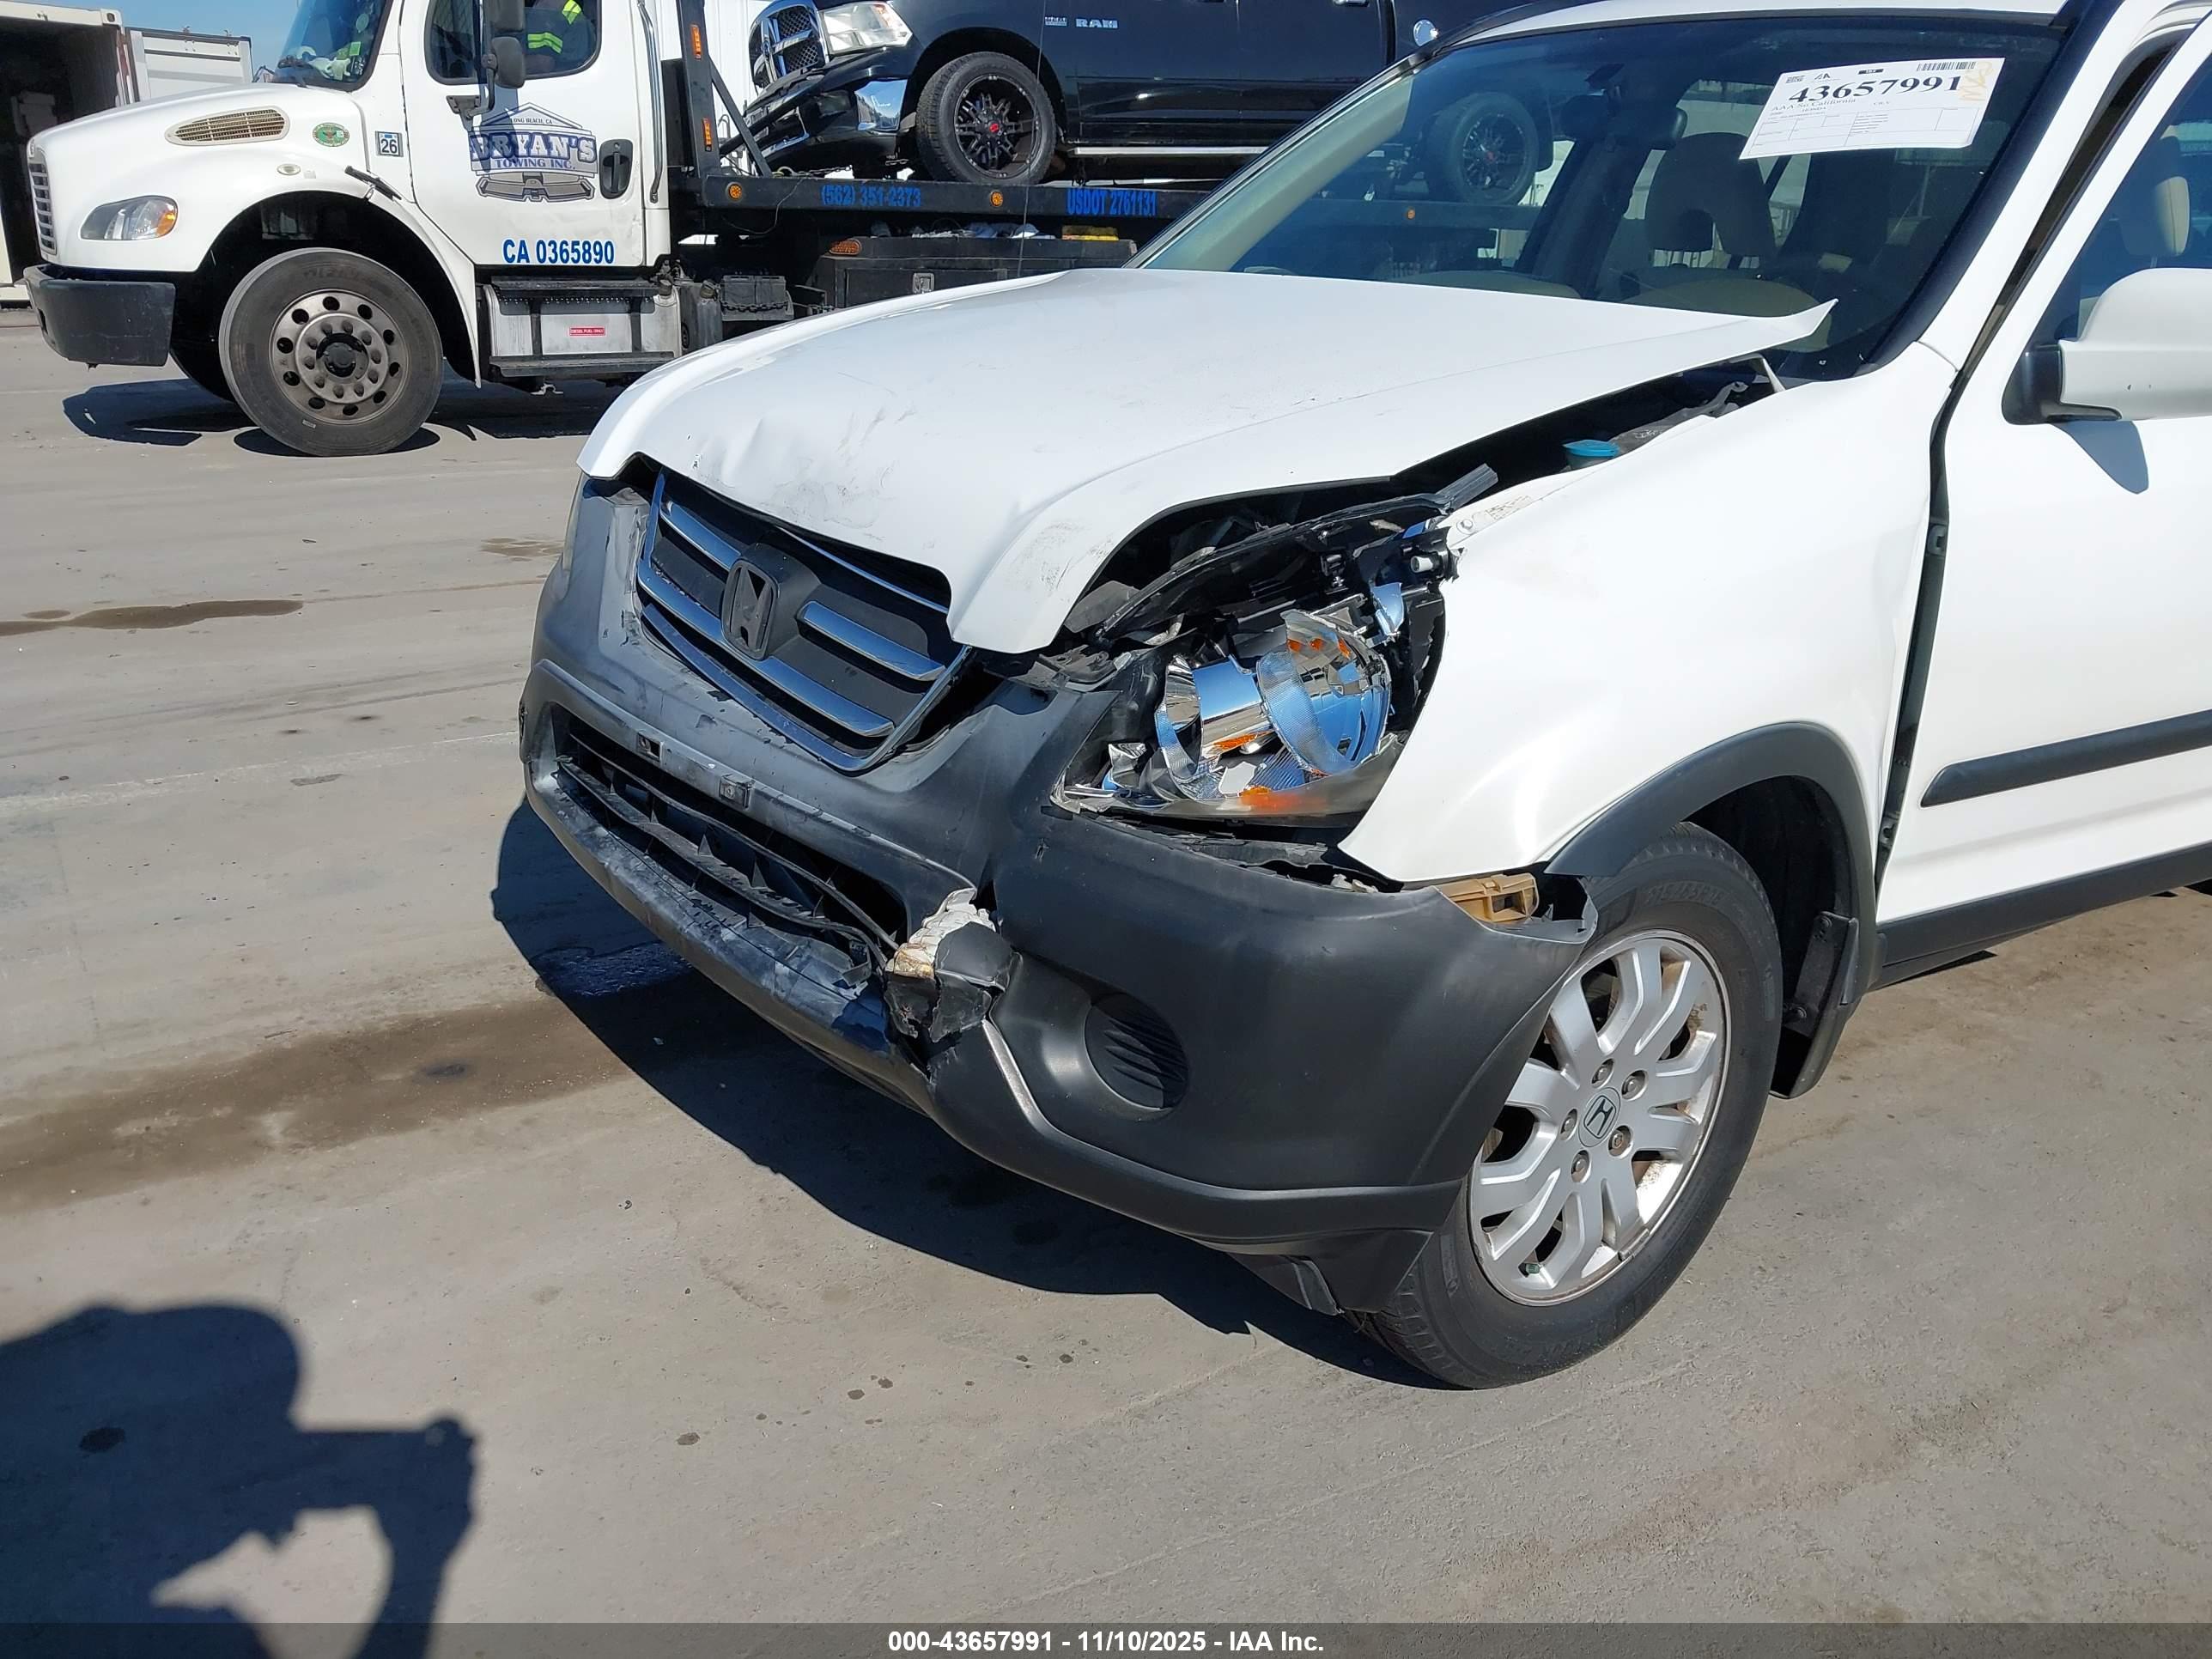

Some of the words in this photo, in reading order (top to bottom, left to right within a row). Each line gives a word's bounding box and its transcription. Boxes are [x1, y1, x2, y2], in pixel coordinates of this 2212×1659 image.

[1076, 18, 1118, 28] RAM
[1789, 76, 1961, 103] 43657991
[380, 138, 398, 154] 26
[471, 132, 597, 162] BRYAN'S
[495, 158, 546, 168] TOWING
[550, 159, 576, 170] INC.
[822, 185, 854, 205] (562)
[1067, 187, 1106, 215] USDOT
[503, 239, 530, 264] CA
[536, 240, 614, 264] 0365890
